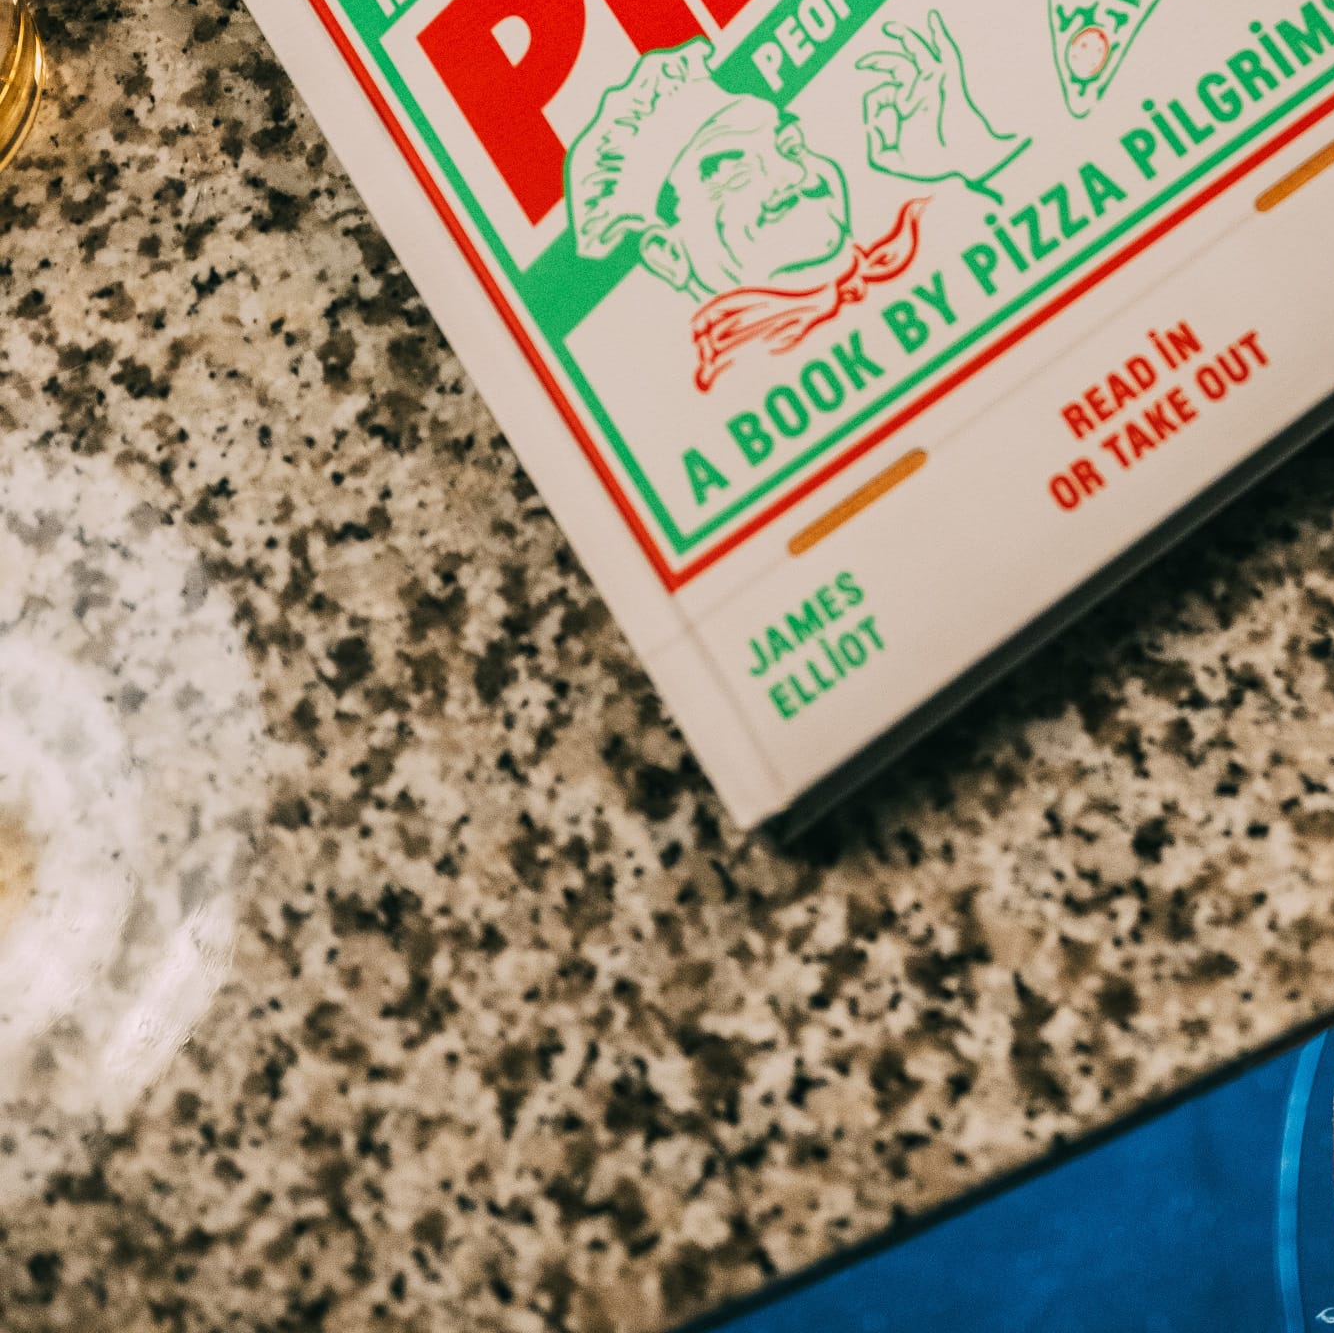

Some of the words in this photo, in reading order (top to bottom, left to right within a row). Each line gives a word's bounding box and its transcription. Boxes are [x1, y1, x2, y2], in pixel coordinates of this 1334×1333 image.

[681, 446, 731, 506] A
[725, 330, 886, 468] BOOK
[881, 270, 959, 356] BY
[1049, 458, 1105, 512] OR
[1101, 385, 1199, 469] TAKE
[1195, 330, 1269, 401] OUT
[1060, 355, 1158, 439] READ
[749, 571, 864, 677] JAMES
